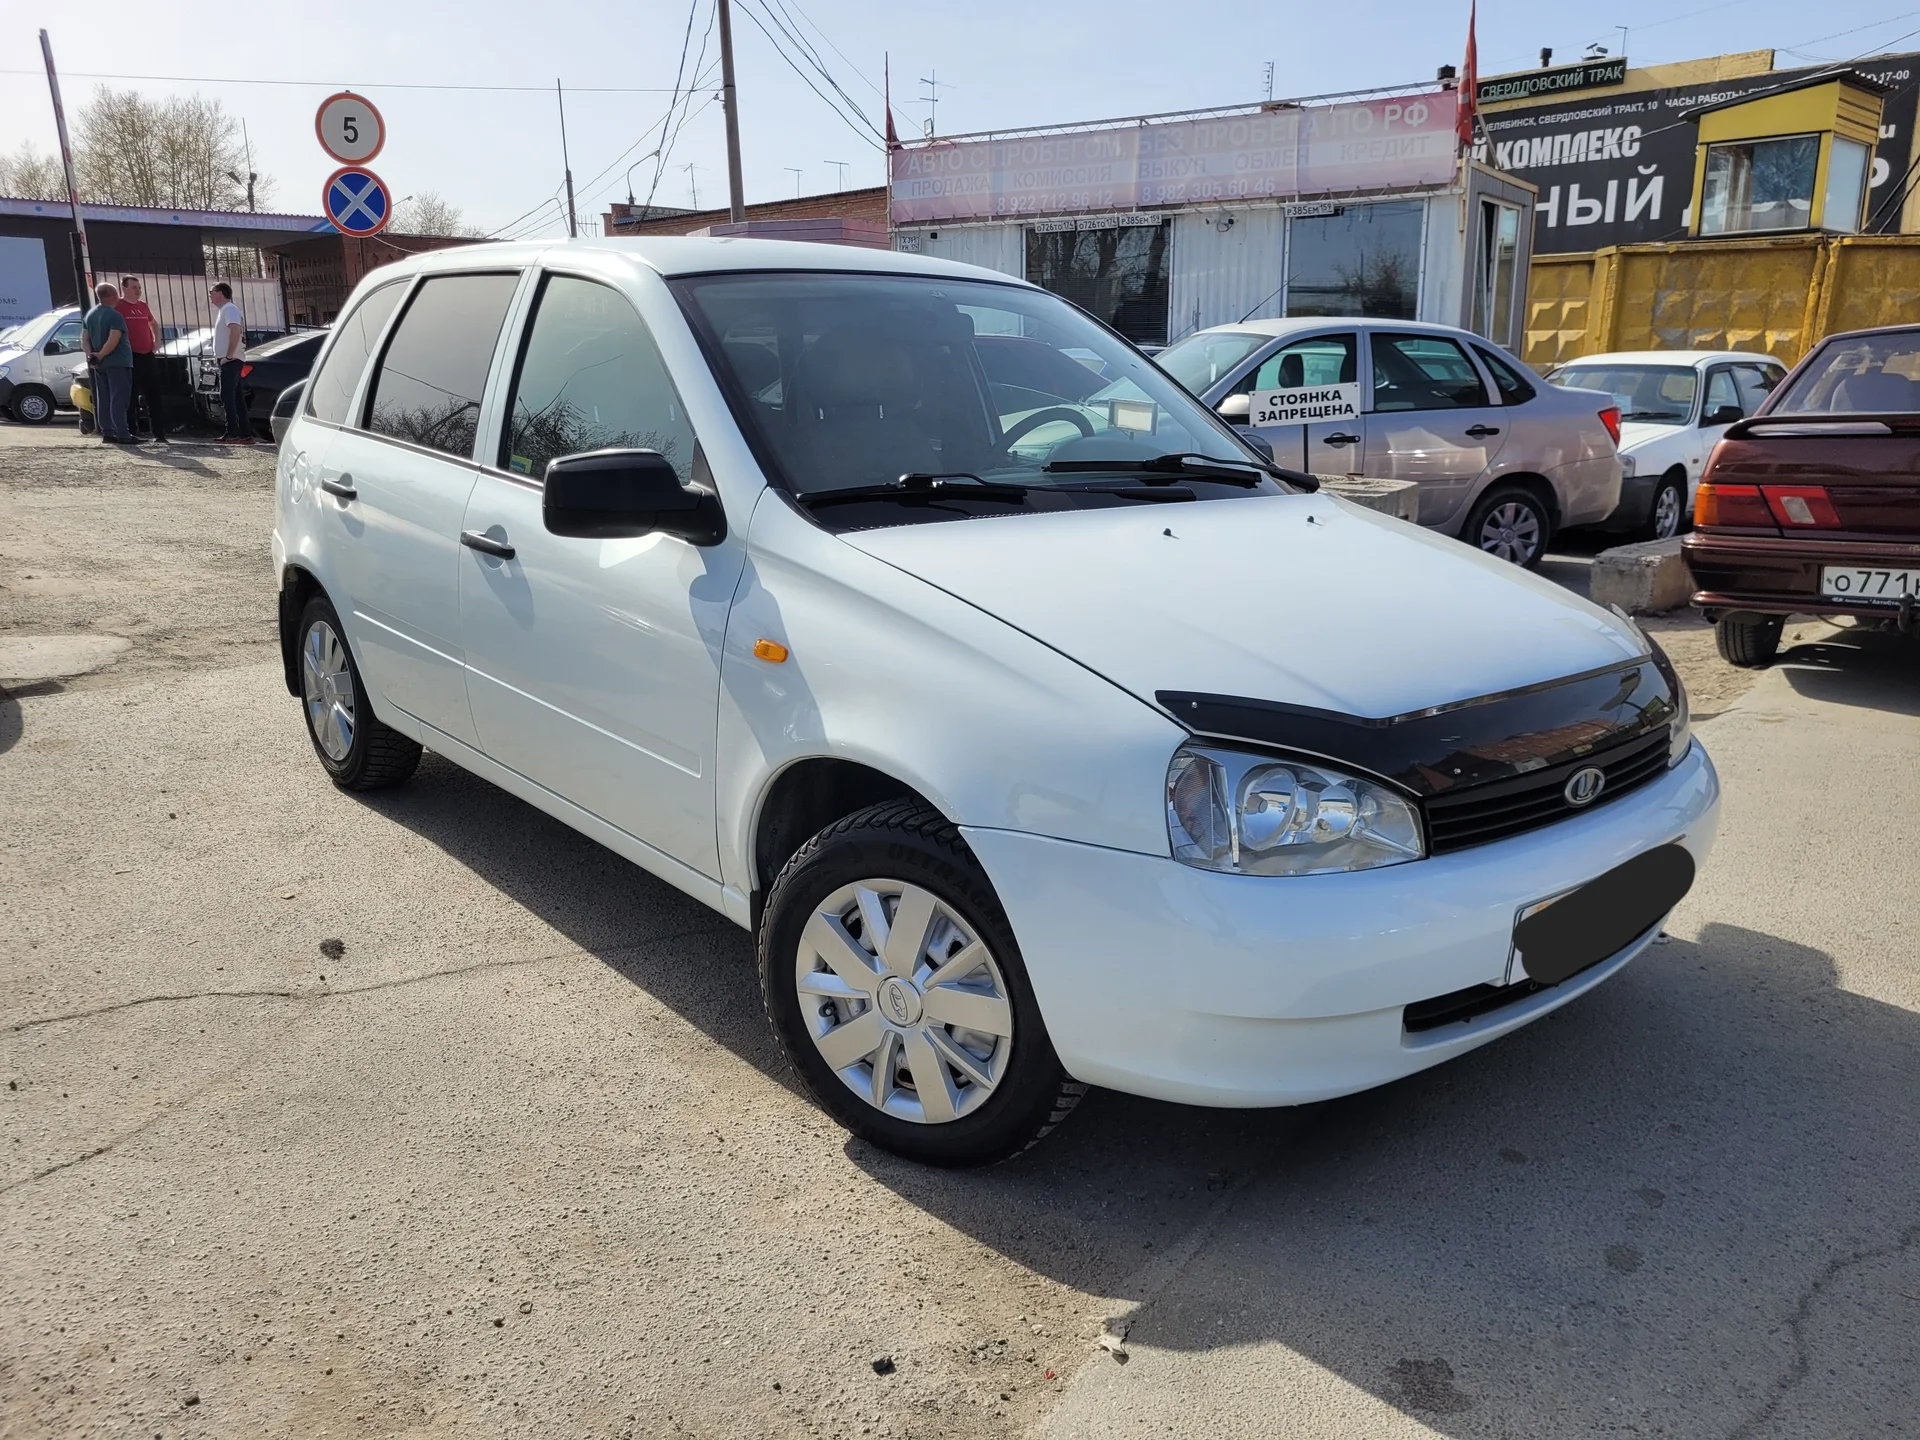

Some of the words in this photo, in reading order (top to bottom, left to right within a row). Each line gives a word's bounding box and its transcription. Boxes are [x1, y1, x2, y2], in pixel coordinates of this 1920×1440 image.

[1588, 65, 1624, 83] ТРАК
[1538, 105, 1612, 125] СВЕРДЛОВСКИЙ
[1647, 101, 1658, 111] 10
[1665, 95, 1696, 108] ЧАСЫ
[343, 116, 359, 144] 5
[907, 151, 964, 175] АВТО
[1384, 101, 1429, 130] РФ
[1495, 125, 1642, 170] КОМПЛЕКС
[911, 174, 991, 197] ПРОДАЖА
[1013, 164, 1112, 189] КОМИССИЯ
[1138, 157, 1206, 179] ВЫКУП
[1234, 146, 1310, 171] ОБМЕН
[1340, 135, 1430, 162] КРЕДИТ
[997, 197, 1005, 213] 8
[1010, 195, 1035, 212] 922
[1072, 191, 1089, 207] 96
[1142, 186, 1152, 202] 8
[1156, 184, 1186, 200] 982
[1192, 181, 1222, 198] 305
[1228, 179, 1248, 195] 60
[1254, 176, 1275, 193] 46
[202, 213, 299, 230] СТРАХОВАНИЕ
[1269, 389, 1342, 406] СТОЯНКА
[1258, 403, 1354, 422] ЗАПРЕЩЕНА
